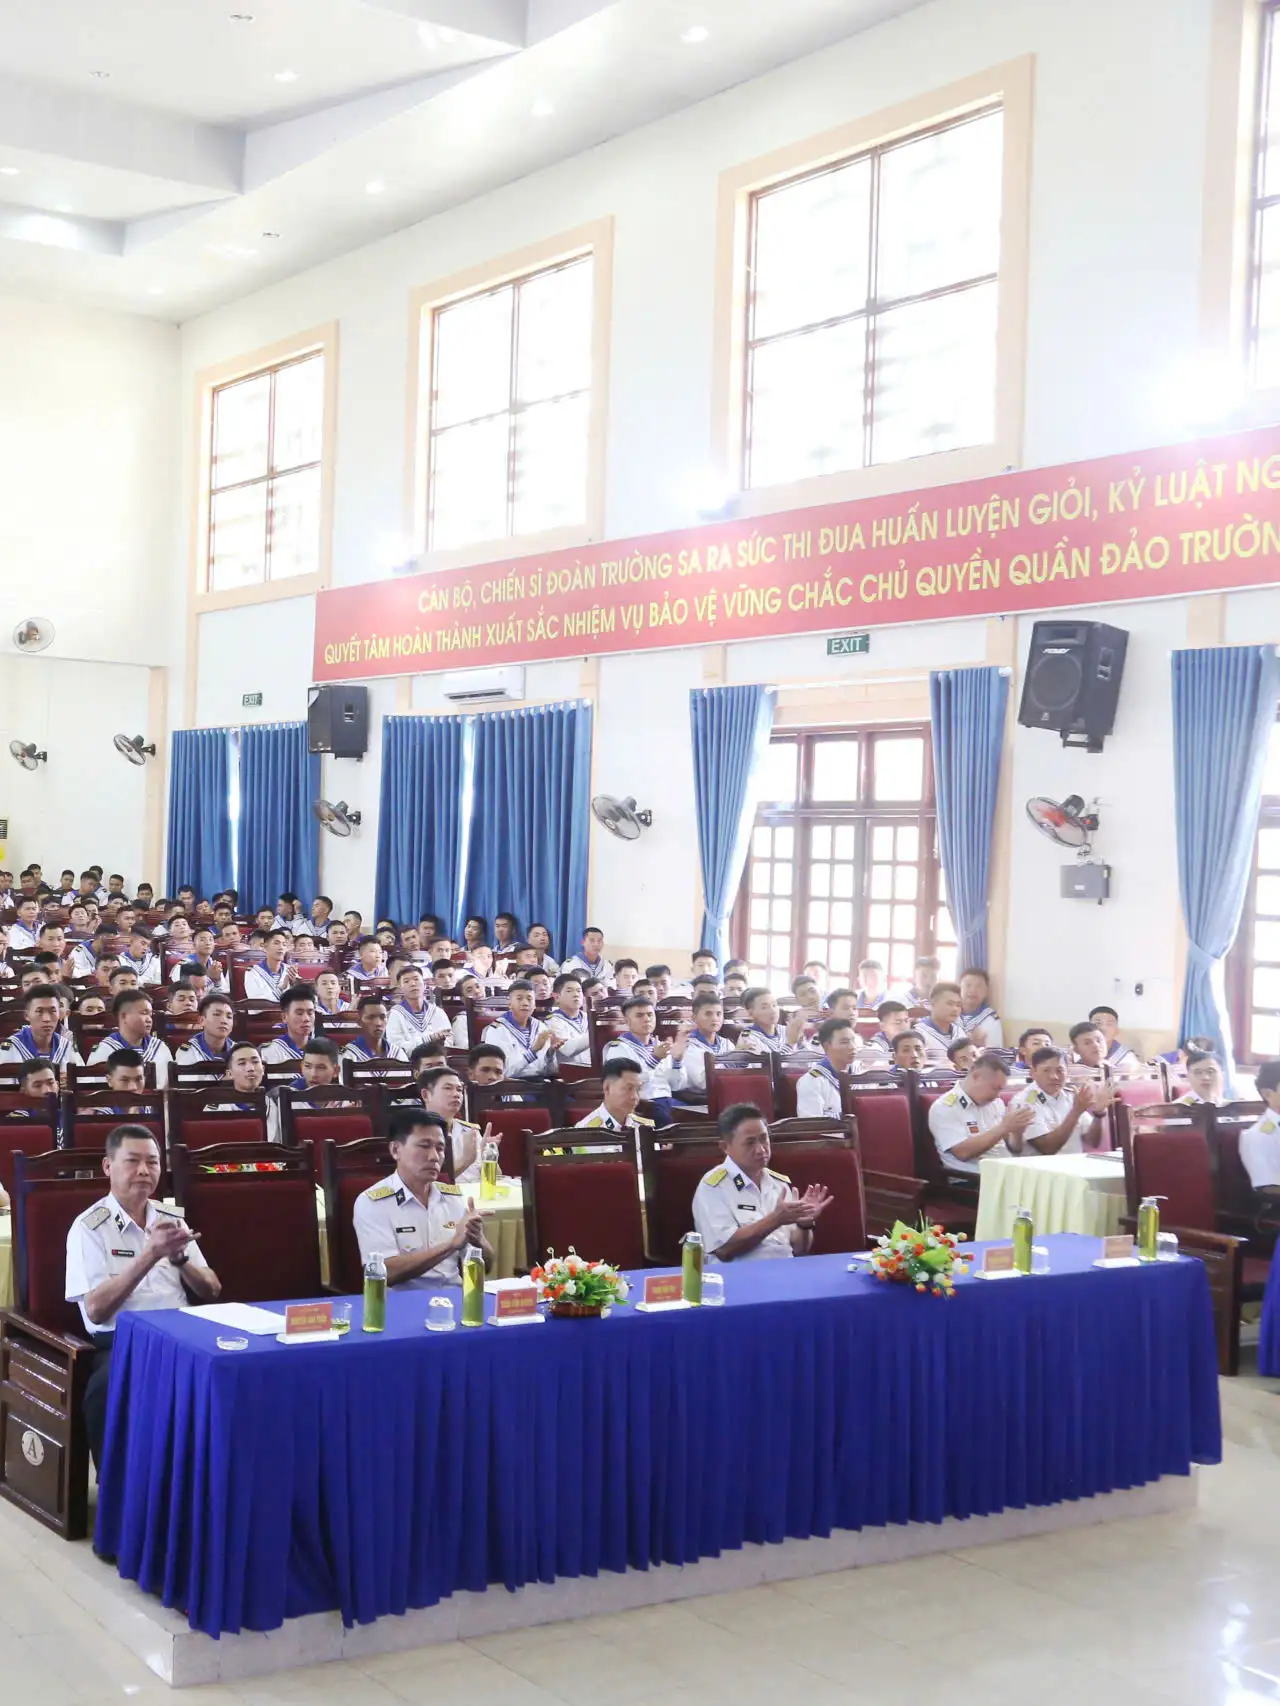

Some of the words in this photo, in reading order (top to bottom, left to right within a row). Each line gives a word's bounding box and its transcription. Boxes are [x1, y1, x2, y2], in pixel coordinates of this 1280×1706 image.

[324, 632, 362, 665] QUYẾT
[364, 633, 390, 660] TÂM
[393, 626, 432, 658] HOÀN
[436, 621, 482, 652] THÀNH
[485, 611, 523, 646] XUẤT
[527, 605, 560, 642] SẮC
[564, 604, 615, 640] NHIỆM
[620, 604, 644, 635] VỤ
[649, 590, 689, 628] BẢO
[694, 586, 717, 628] VỆ
[723, 583, 782, 619] VỮNG
[788, 565, 853, 611] CHẮC
[859, 559, 909, 603] CHỦ
[915, 547, 1001, 597] QUYỀN
[1008, 535, 1091, 587] QUẦN
[1099, 526, 1170, 576] ĐẢO
[419, 585, 449, 613] CÁN
[481, 568, 525, 604] CHIẾN
[546, 560, 596, 594] ĐOÀN
[601, 548, 673, 587] TRƯỜNG
[677, 549, 702, 576] SA
[706, 543, 733, 573] RA
[782, 531, 812, 561] THI
[818, 522, 866, 555] ĐUA
[872, 501, 939, 548] HUẤN
[946, 493, 1020, 538] LUYỆN
[1028, 476, 1098, 525] GIỎI,
[1108, 465, 1146, 513] KỶ
[1154, 458, 1228, 509] LUẬT
[831, 636, 863, 653] EXIT
